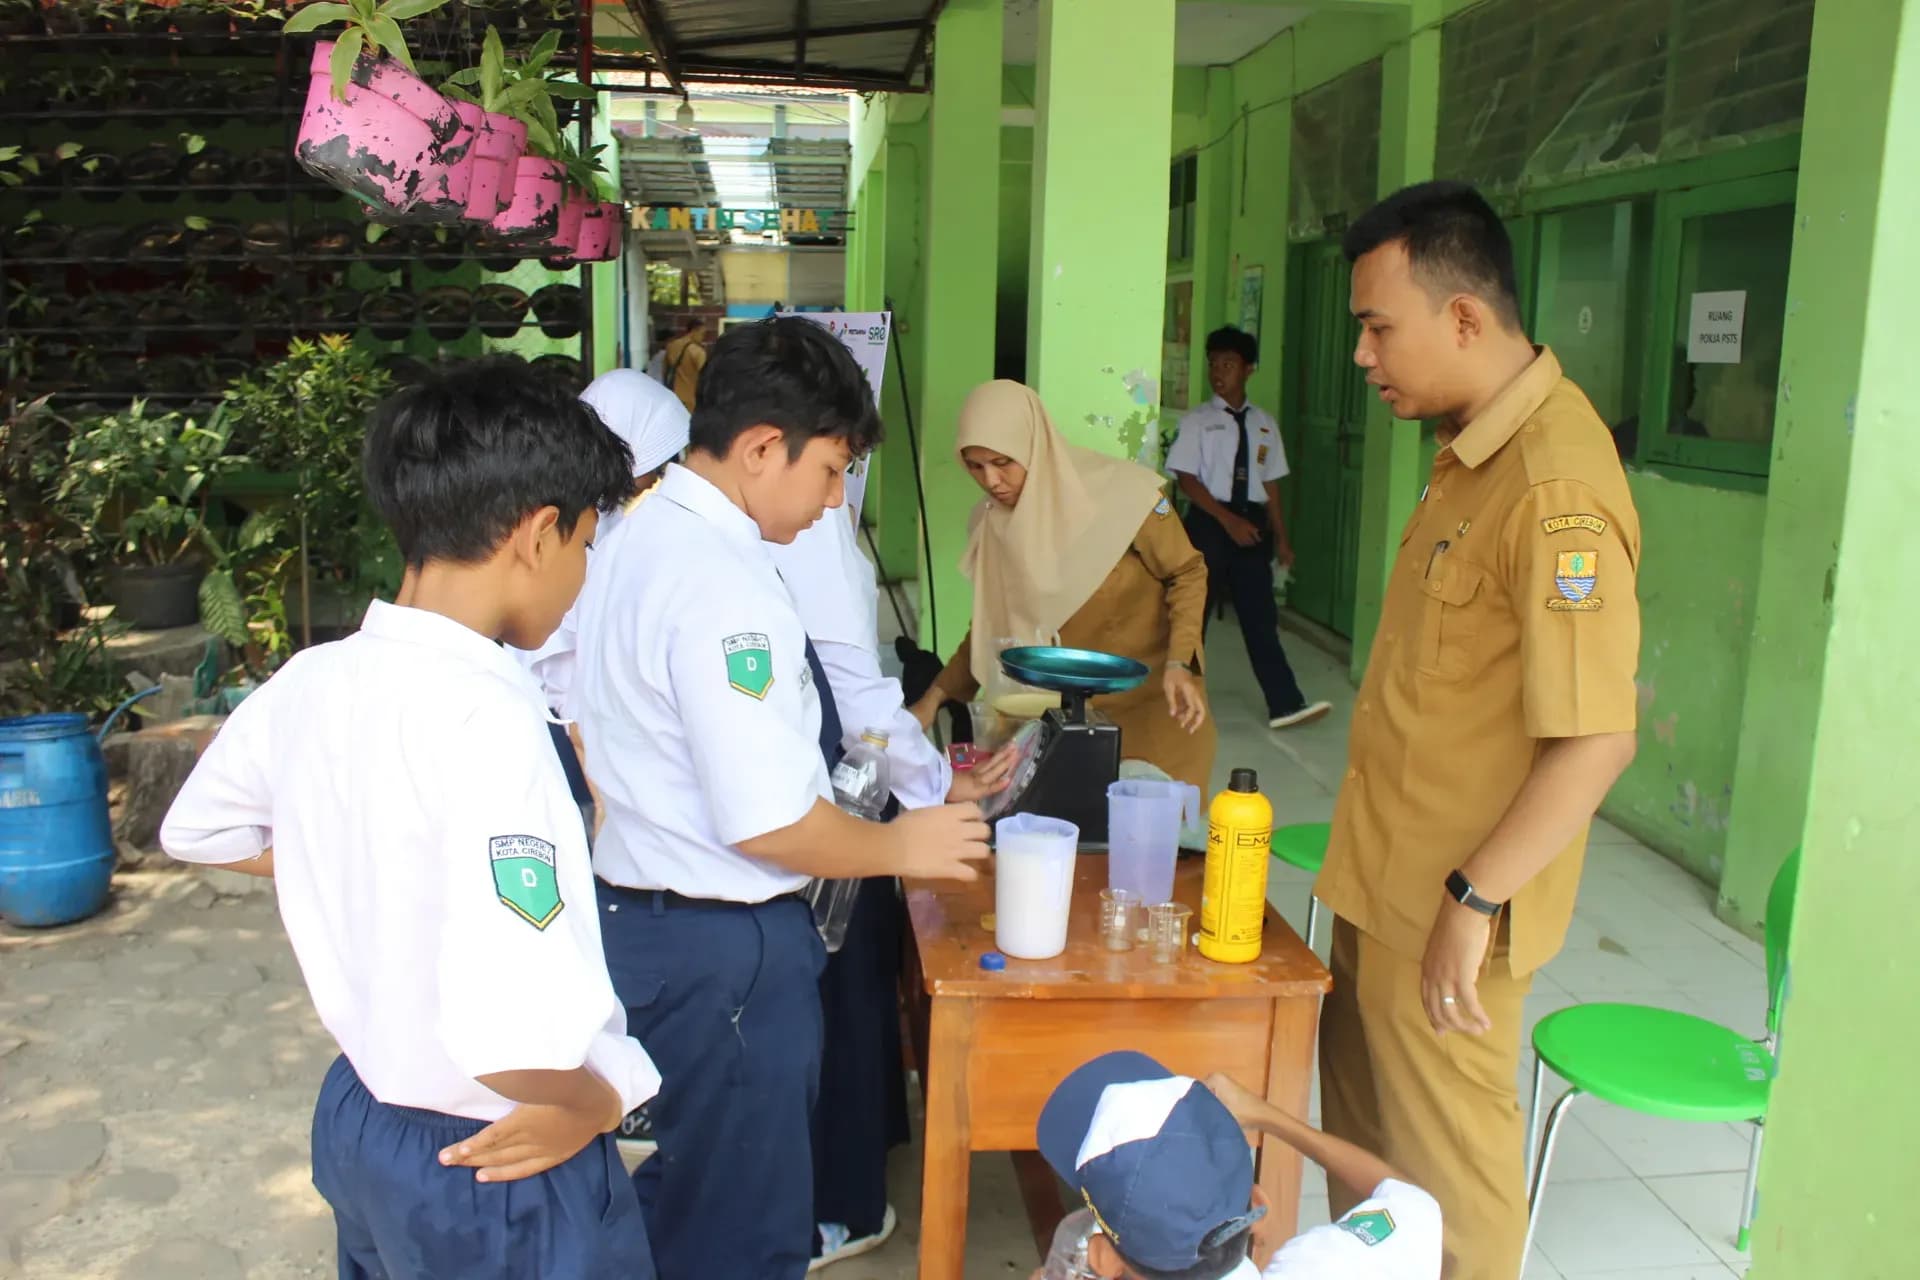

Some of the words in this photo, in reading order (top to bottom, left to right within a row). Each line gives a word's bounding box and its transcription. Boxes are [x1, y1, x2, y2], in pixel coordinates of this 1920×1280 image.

[631, 206, 734, 231] KANTIN
[743, 208, 836, 232] SEHAT
[1708, 311, 1733, 321] RUANG
[1547, 518, 1570, 530] KOTA
[1574, 517, 1603, 530] CIREBON
[745, 656, 757, 671] D
[495, 838, 515, 848] SMP
[496, 847, 520, 857] KOTA
[521, 847, 552, 863] CIREBON
[521, 867, 538, 888] D
